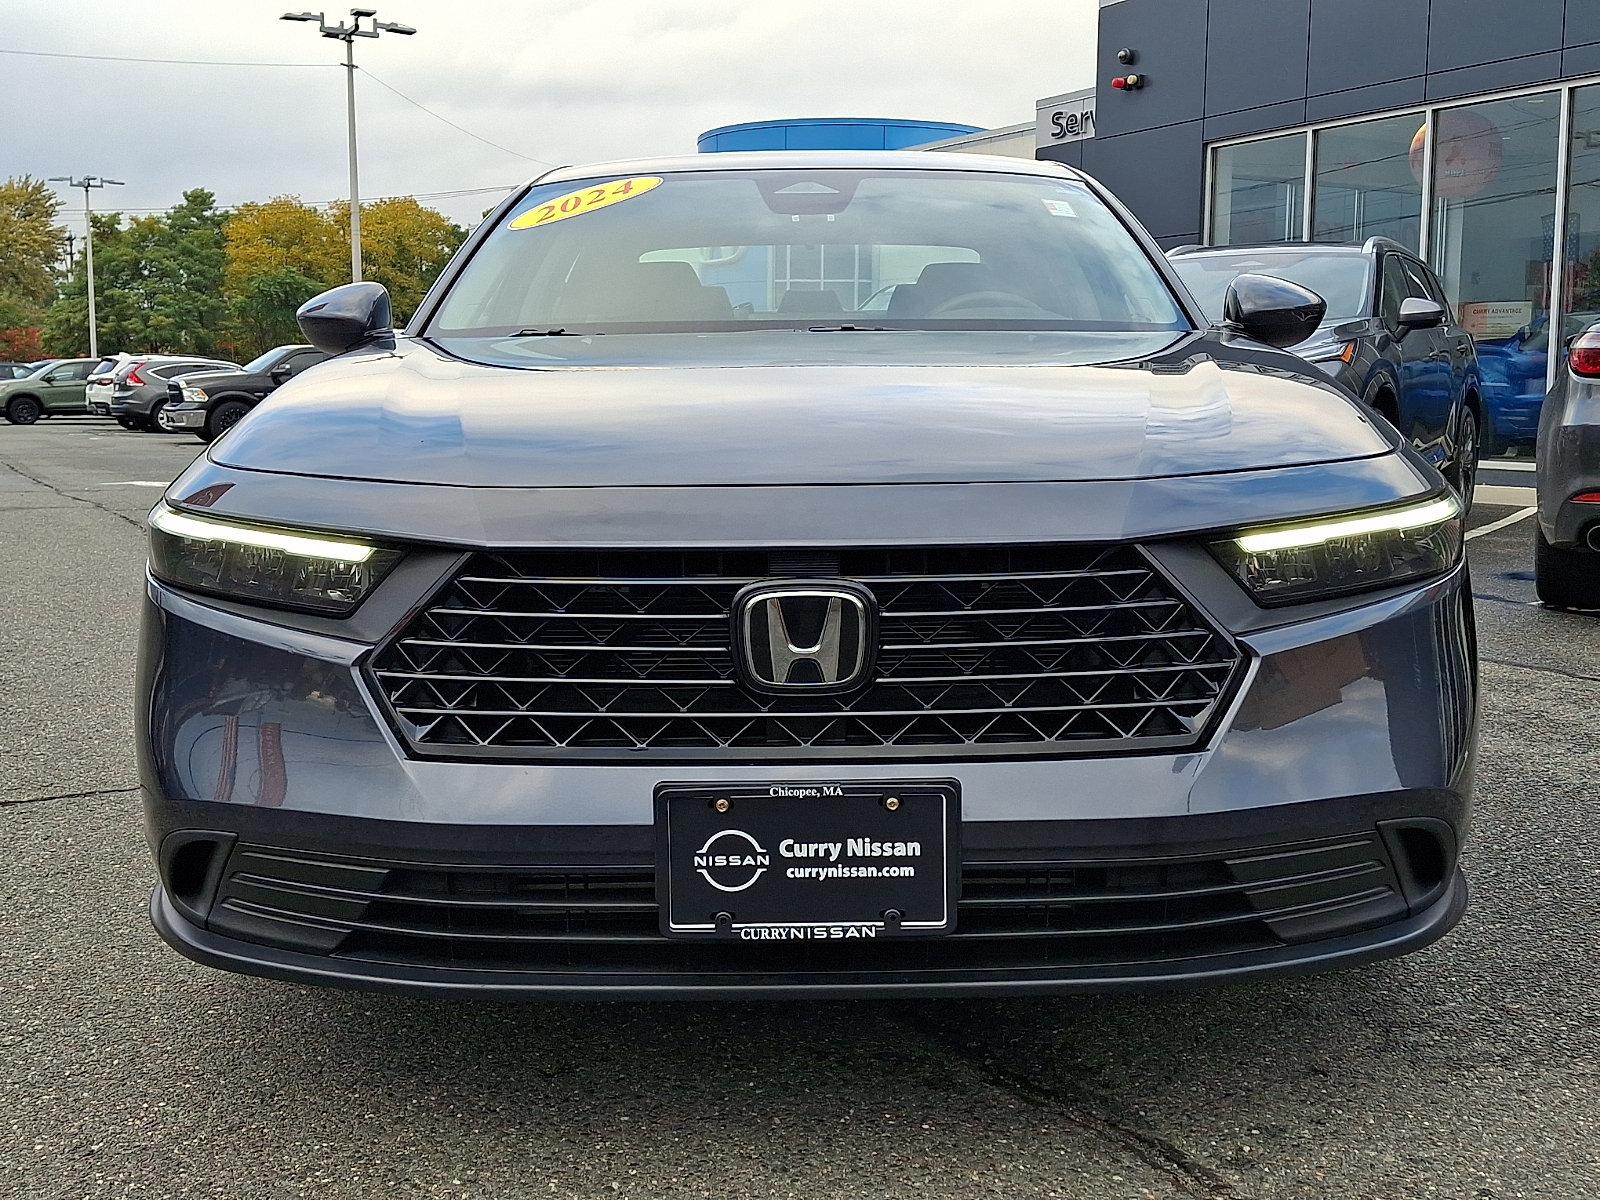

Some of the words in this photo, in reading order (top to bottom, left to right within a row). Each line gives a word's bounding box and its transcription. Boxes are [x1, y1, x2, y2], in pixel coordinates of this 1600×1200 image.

[536, 180, 633, 224] 2024
[769, 786, 821, 798] Chicopee,
[822, 786, 843, 796] MA
[779, 838, 843, 862] Curry
[847, 837, 921, 857] Nissan
[693, 855, 770, 867] NISSAN
[786, 864, 915, 881] currynissan.com
